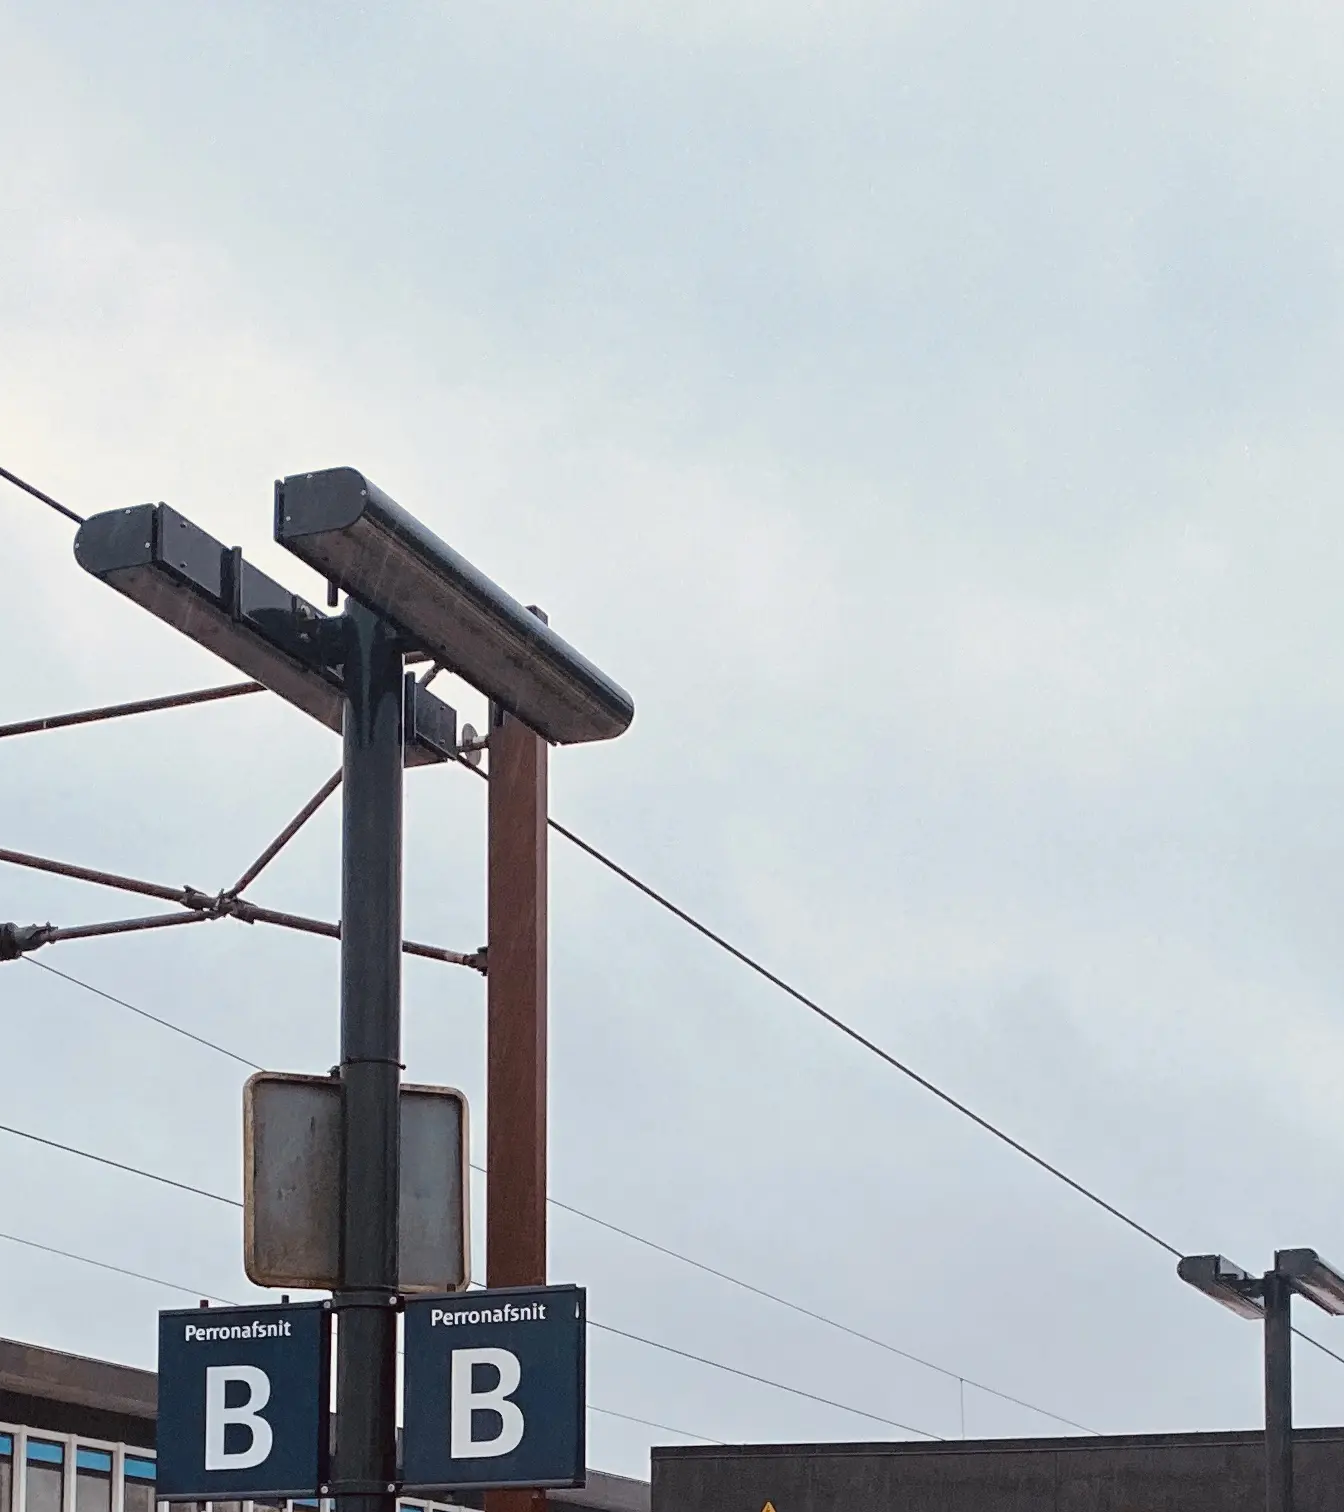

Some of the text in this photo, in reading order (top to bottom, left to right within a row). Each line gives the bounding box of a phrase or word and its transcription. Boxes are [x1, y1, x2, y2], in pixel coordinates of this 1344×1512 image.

[185, 1319, 292, 1342] Perronafsnit
[431, 1302, 547, 1327] Perronafsnit
[205, 1364, 274, 1471] B
[450, 1347, 525, 1459] B
